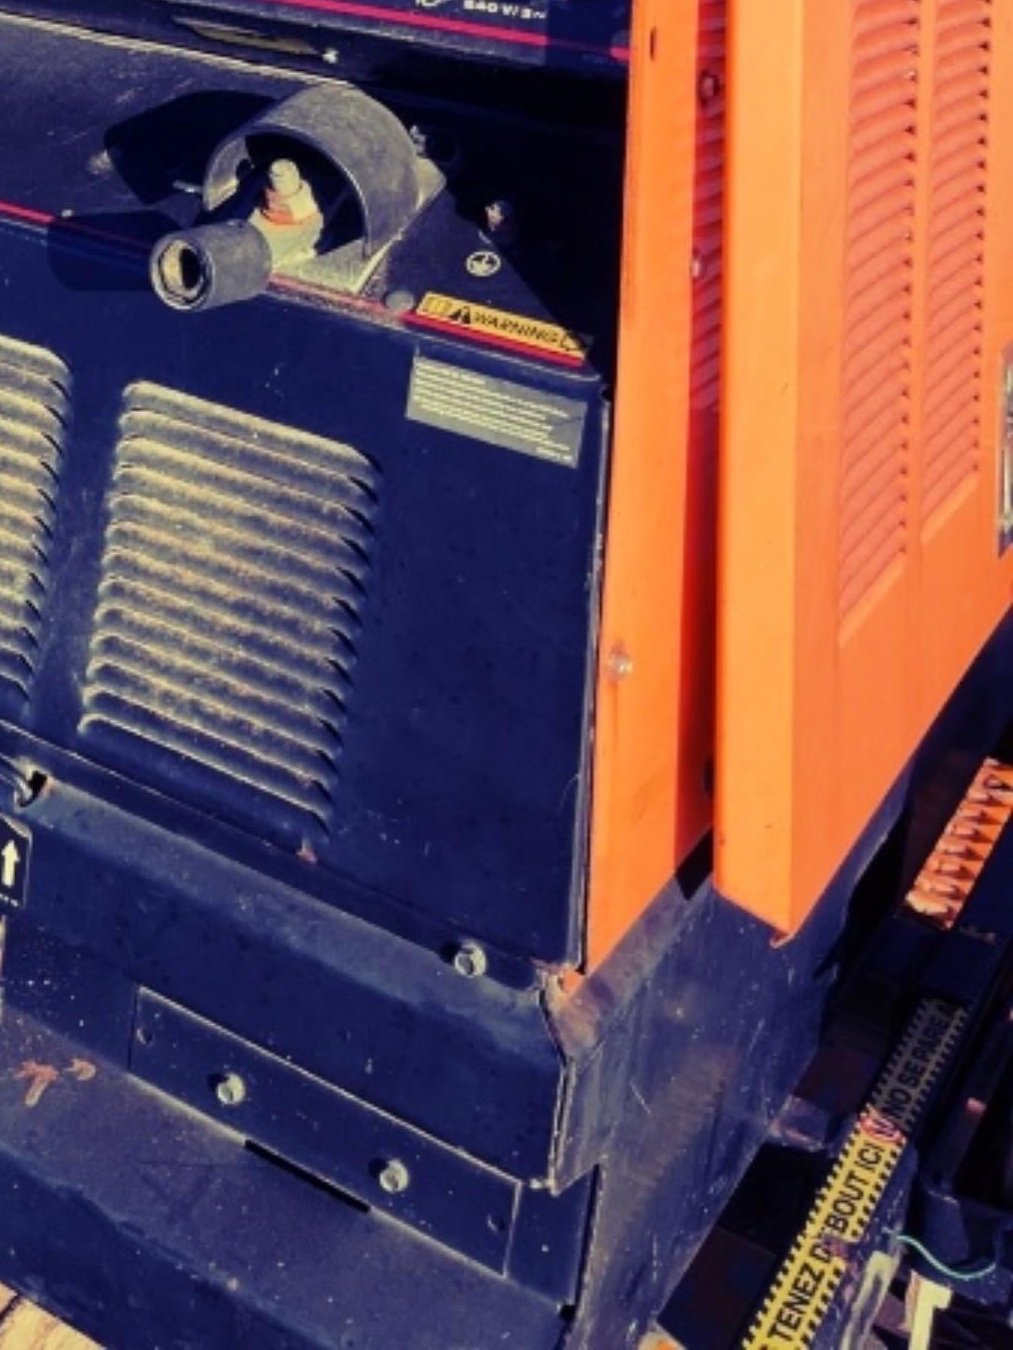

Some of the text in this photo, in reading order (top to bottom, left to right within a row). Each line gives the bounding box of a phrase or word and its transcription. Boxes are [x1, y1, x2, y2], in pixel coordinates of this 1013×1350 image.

[474, 311, 559, 344] WARNING
[768, 1140, 886, 1340] TENEZ DBOUT ICI
